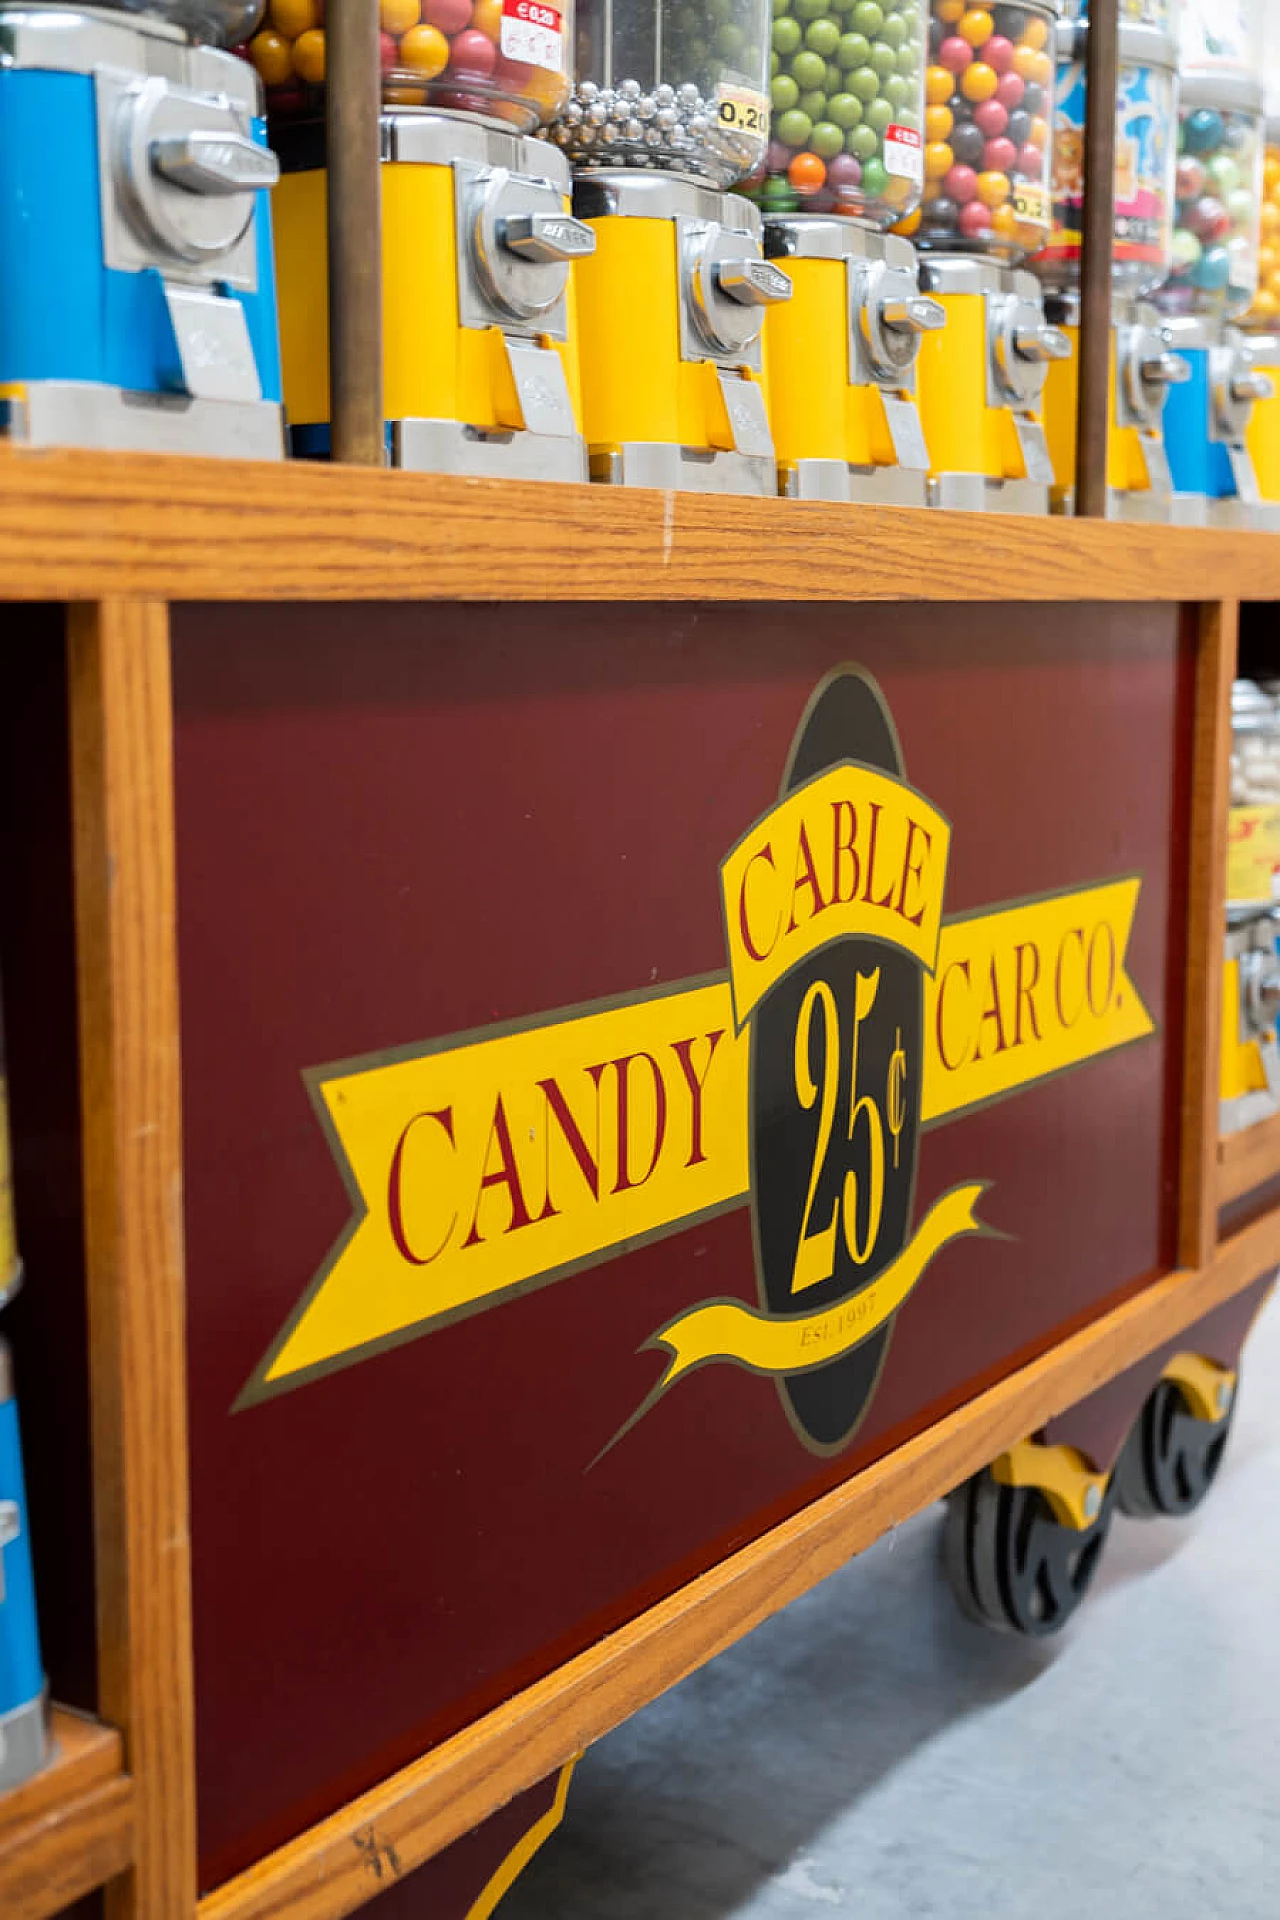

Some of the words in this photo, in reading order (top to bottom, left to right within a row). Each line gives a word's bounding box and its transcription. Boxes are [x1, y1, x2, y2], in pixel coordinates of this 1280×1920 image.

[740, 800, 932, 961] CABLE
[936, 941, 1041, 1071] CAR
[1055, 921, 1122, 1029] CO.
[388, 1030, 725, 1266] CANDY
